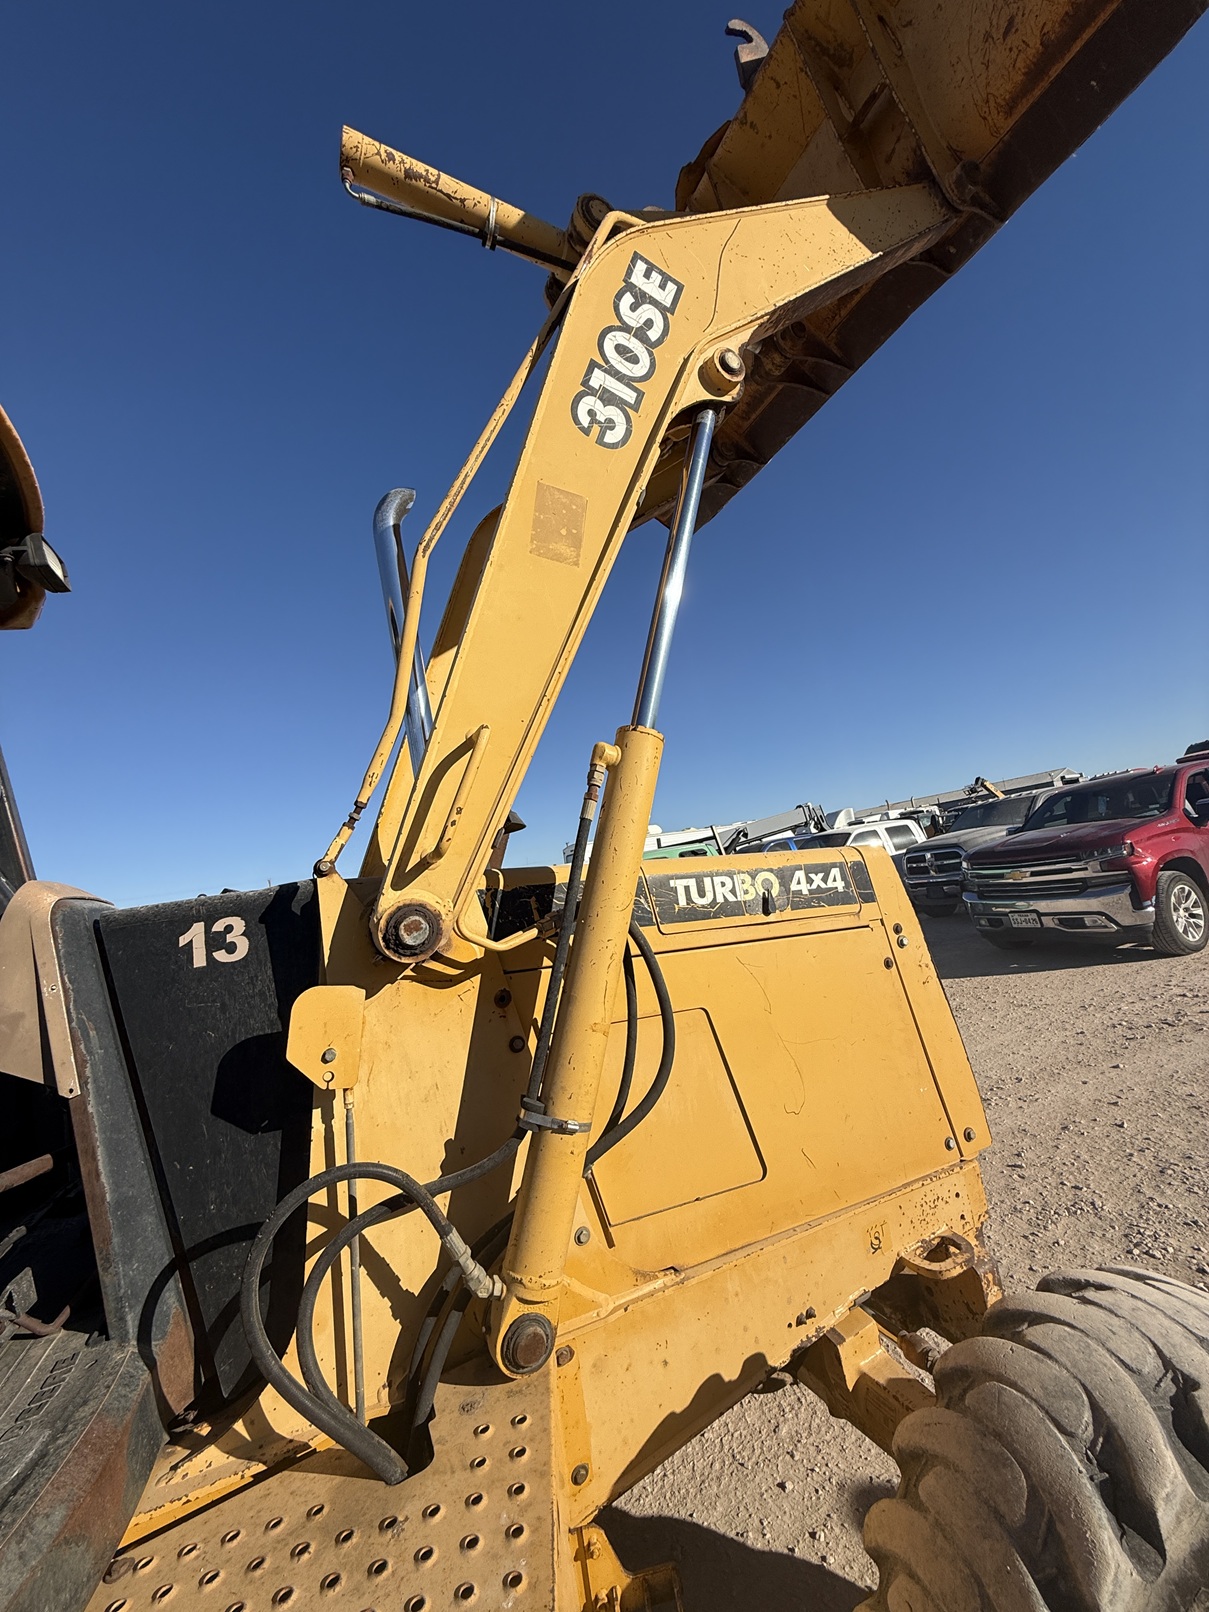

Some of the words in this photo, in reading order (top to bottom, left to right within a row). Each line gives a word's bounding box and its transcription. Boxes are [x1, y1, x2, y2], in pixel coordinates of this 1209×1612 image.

[573, 253, 682, 447] 310SE
[670, 871, 780, 907] TURBO
[790, 867, 845, 895] 4x4
[178, 916, 250, 968] 13
